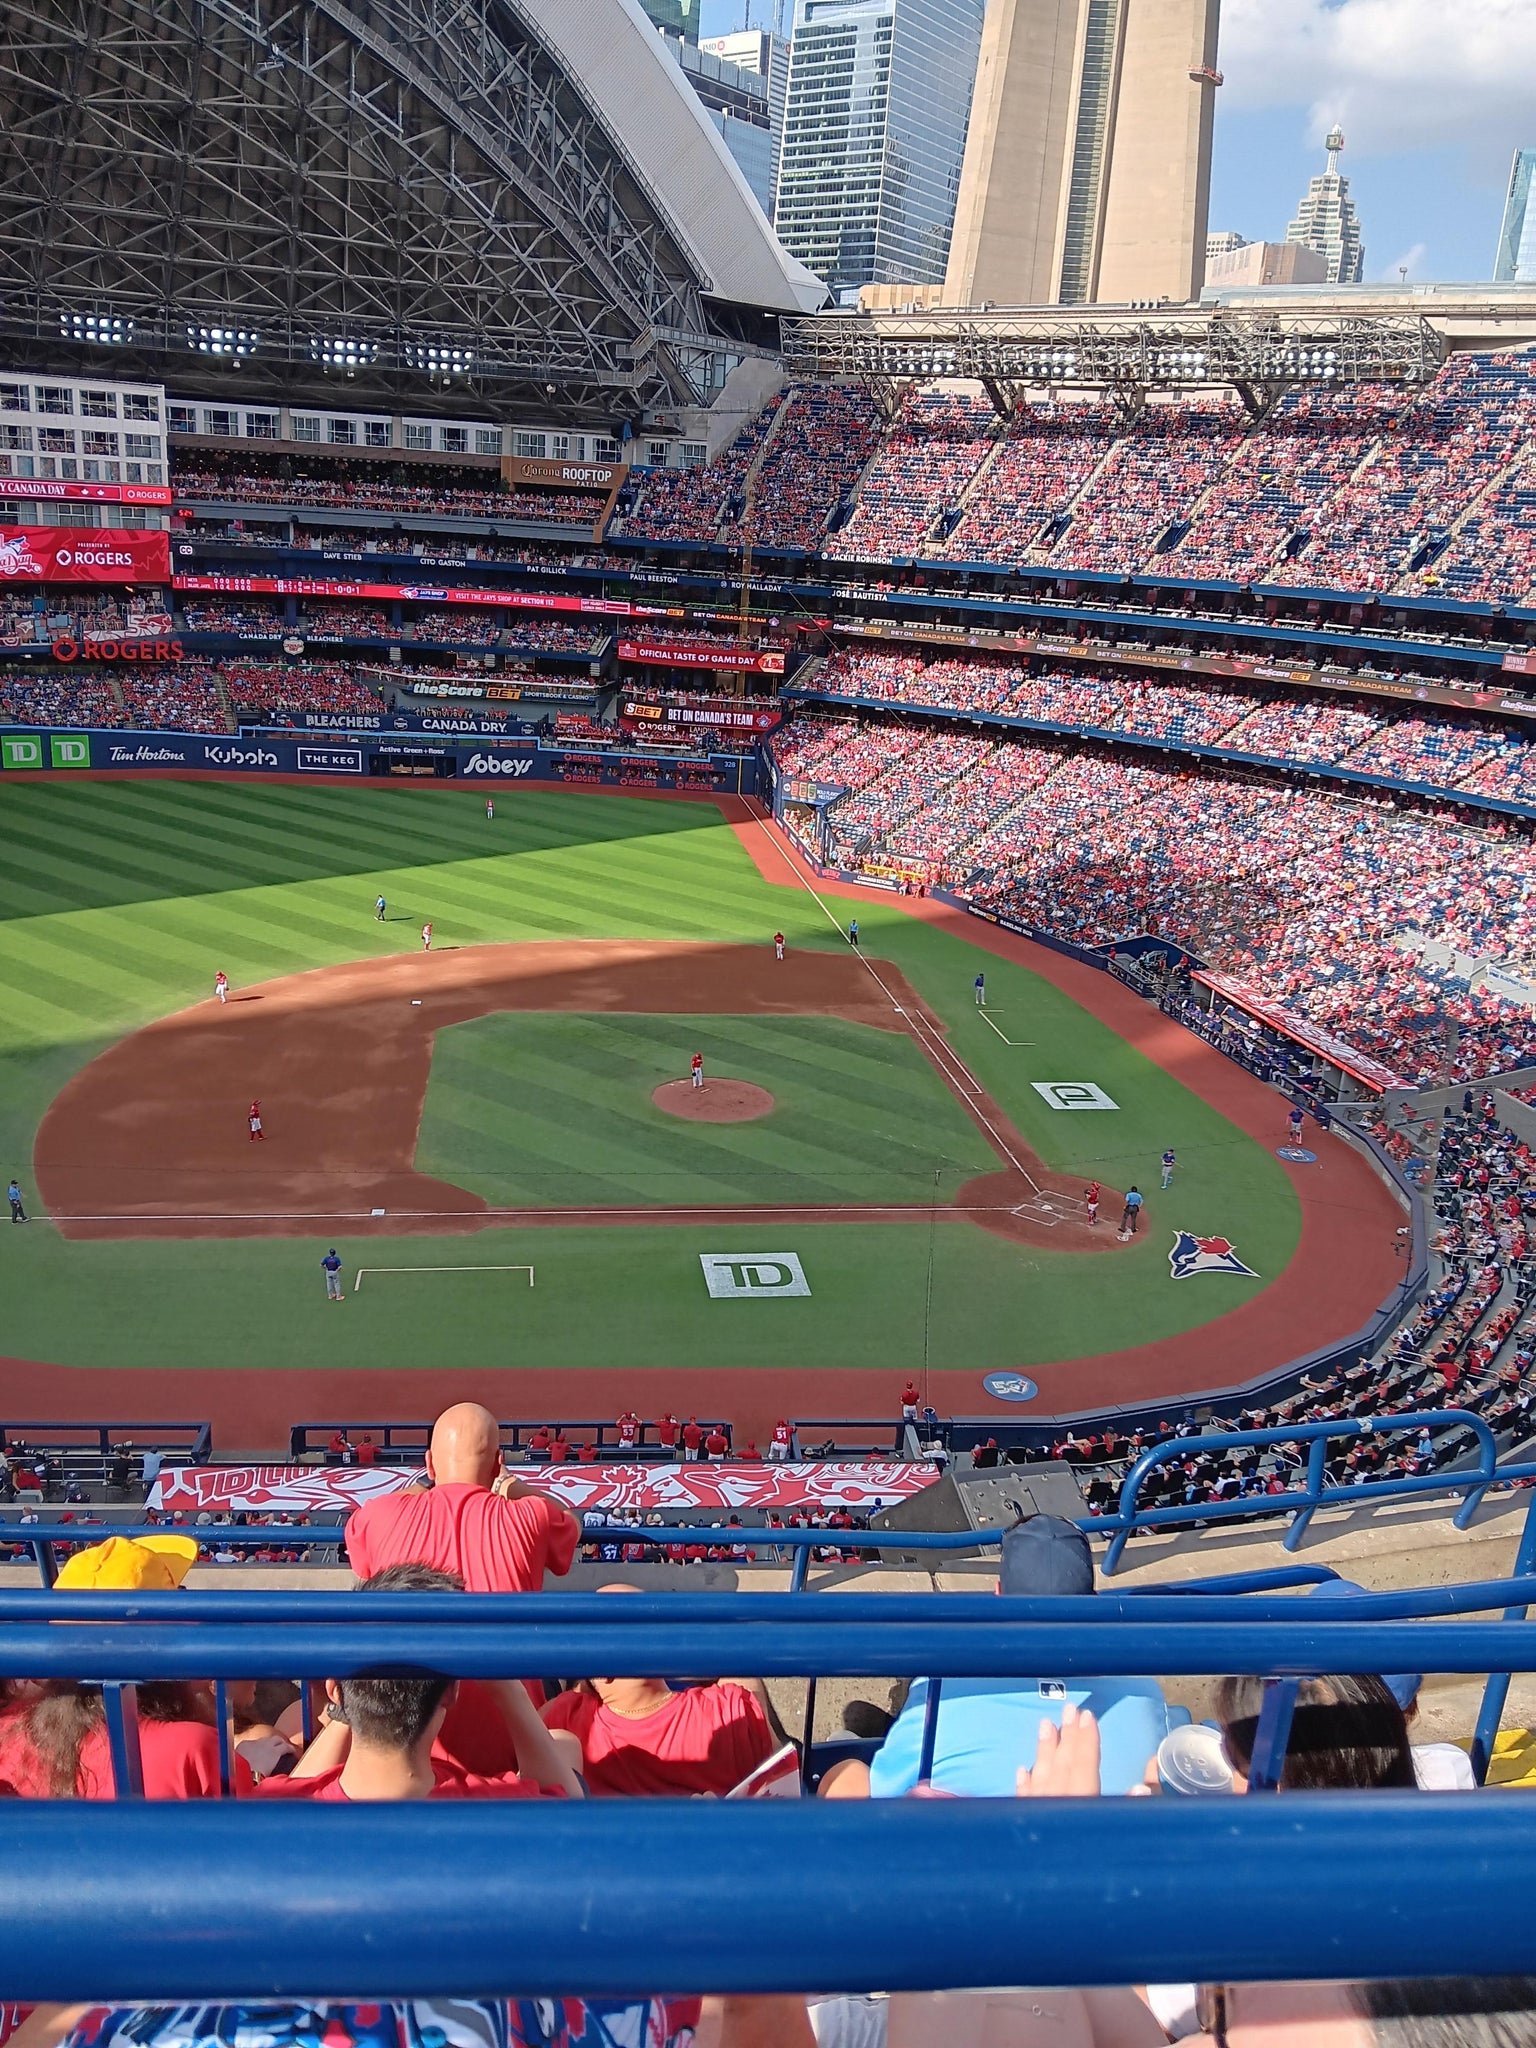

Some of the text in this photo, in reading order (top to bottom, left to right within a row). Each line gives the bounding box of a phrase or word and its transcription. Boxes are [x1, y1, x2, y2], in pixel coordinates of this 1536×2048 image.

[521, 463, 612, 483] Corona ROOFTOP
[8, 483, 48, 495] CANADA
[48, 485, 66, 496] DAY
[136, 491, 167, 500] ROGERS
[75, 552, 132, 565] ROGERS
[323, 552, 362, 561] DAVE STIEB
[831, 554, 855, 563] JACKIE
[856, 554, 893, 565] ROBINSON
[420, 558, 466, 567] CITO GASTON
[526, 565, 567, 575] PAT GILLICK
[630, 573, 678, 583] PAUL BEESTON
[731, 581, 745, 589] ROY
[746, 583, 782, 592] HALLADAY
[520, 597, 544, 605] SECTION
[852, 591, 888, 601] BAUTISTA
[636, 606, 666, 615] theScore
[832, 623, 865, 633] theScore
[914, 632, 946, 640] CANADA'S
[306, 635, 343, 643] BLEACHERS
[84, 640, 184, 661] ROGERS
[1036, 643, 1069, 653] theScore
[1122, 653, 1157, 662] CANADA'S
[1158, 657, 1178, 665] TEAM
[639, 649, 672, 659] OFFICIAL
[673, 652, 696, 661] TASTE
[698, 654, 709, 662] OF
[711, 654, 736, 664] GAME
[738, 656, 755, 665] DAY
[1253, 667, 1290, 678] theScore
[1349, 680, 1389, 691] CANADA'S
[1390, 685, 1412, 694] TEAM
[413, 683, 483, 698] theScore
[487, 688, 520, 699] BET
[524, 691, 562, 699] SPORTSBOOK
[636, 706, 661, 718] BET
[668, 708, 753, 726] BET ON CANADA'S TEAM
[305, 714, 381, 729] BLEACHERS
[422, 718, 478, 732] CANADA
[647, 723, 677, 732] ROGERS
[5, 741, 38, 762] TD
[54, 741, 86, 762] TD
[109, 745, 186, 761] Tim Hortons
[204, 746, 278, 766] Kubota
[305, 754, 355, 765] THE KEG
[572, 754, 601, 763] ROGERS
[629, 758, 658, 767] ROGERS
[463, 753, 533, 776] Sobeys
[685, 762, 714, 771] ROGERS
[572, 775, 601, 784] ROGERS
[629, 779, 657, 788] ROGERS
[684, 783, 713, 791] ROGERS
[713, 1262, 794, 1288] TD
[622, 1428, 634, 1436] 53
[776, 1430, 786, 1439] 51
[605, 1548, 618, 1560] 27
